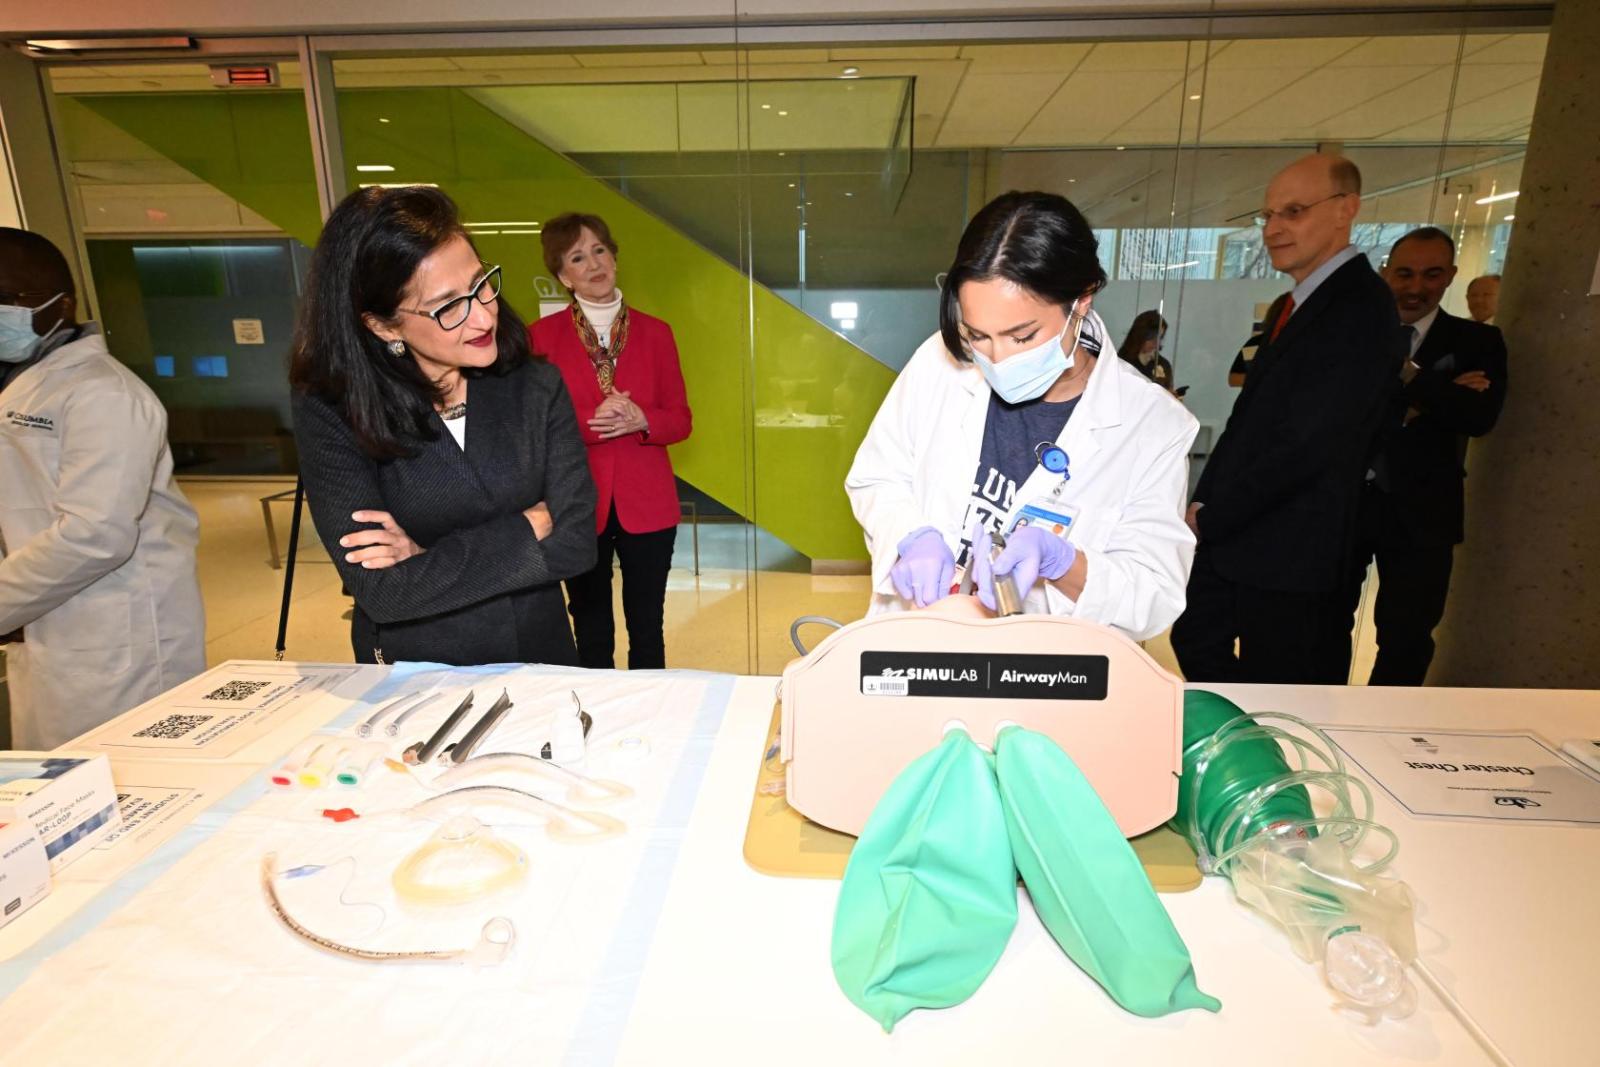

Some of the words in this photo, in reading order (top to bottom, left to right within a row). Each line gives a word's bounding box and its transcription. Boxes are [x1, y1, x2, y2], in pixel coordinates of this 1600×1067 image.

[906, 667, 979, 682] SIMULAB
[1000, 670, 1088, 687] AirwayMan
[1404, 761, 1460, 773] Chest
[1463, 763, 1536, 776] Chester
